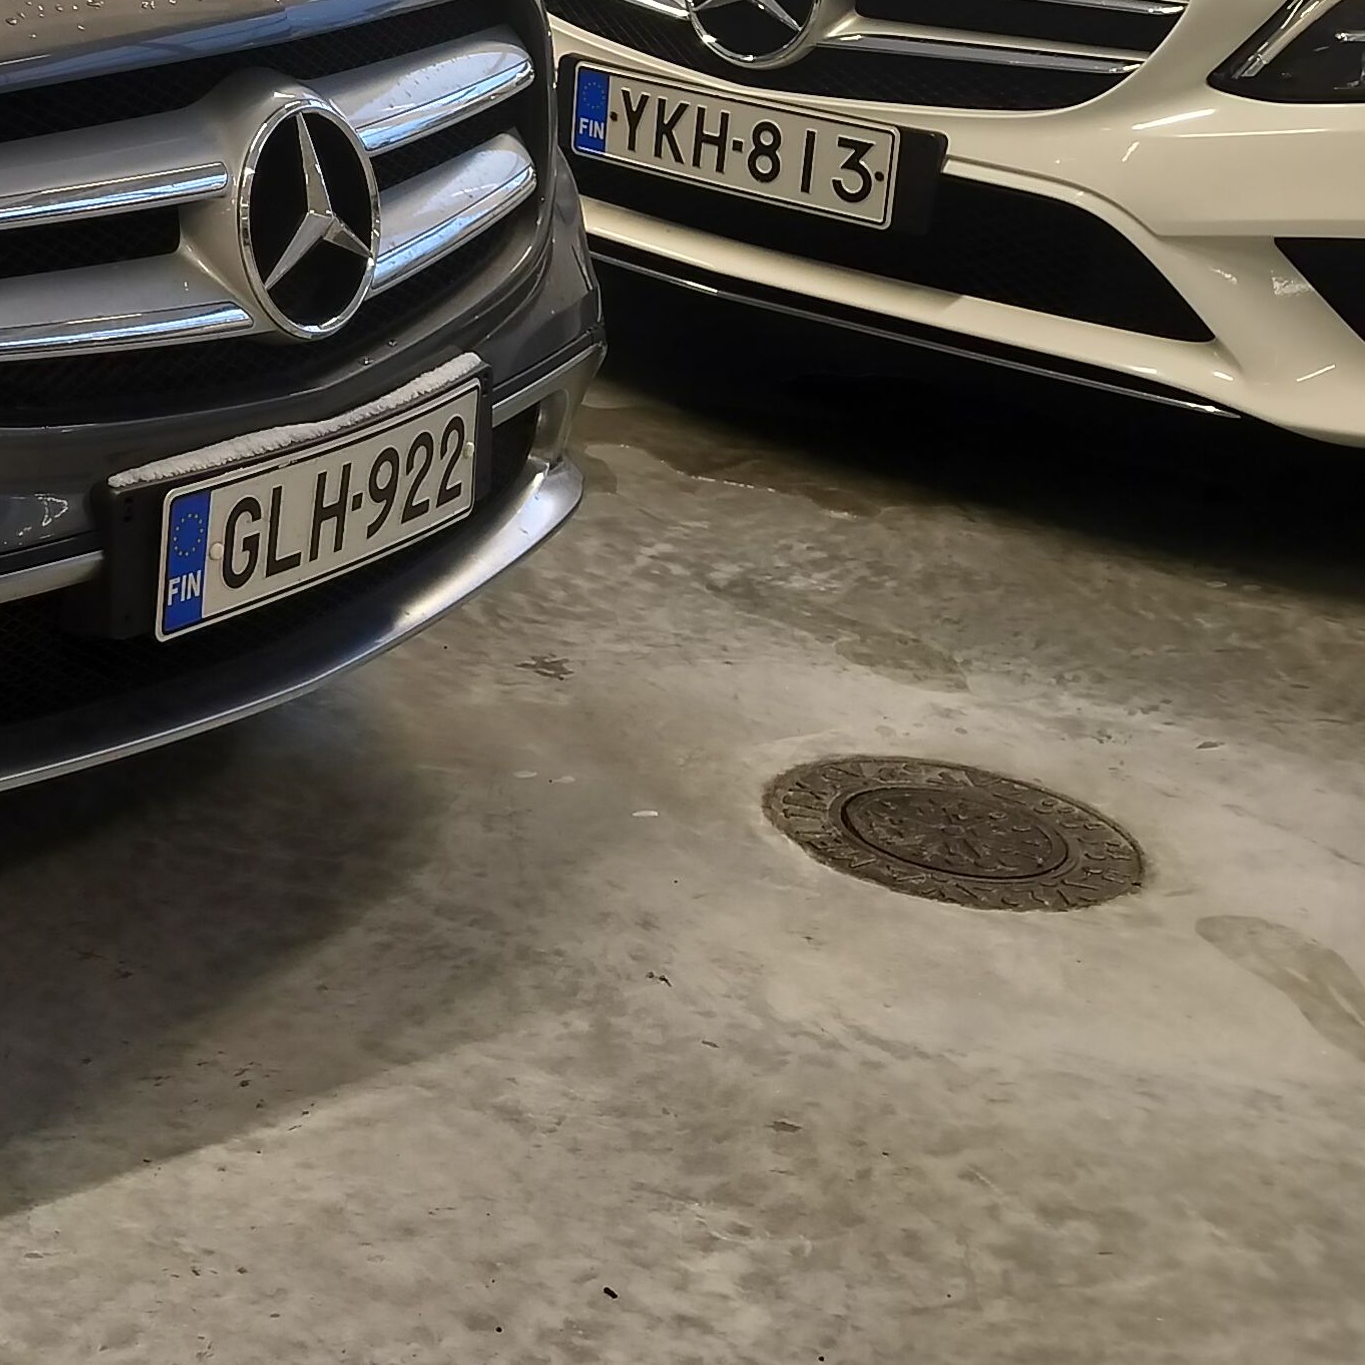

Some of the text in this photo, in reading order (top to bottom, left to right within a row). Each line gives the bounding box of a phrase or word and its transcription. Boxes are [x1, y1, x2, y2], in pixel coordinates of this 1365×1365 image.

[579, 118, 605, 142] FIN
[621, 87, 876, 203] YKH-813
[222, 416, 466, 590] GLH-922
[168, 570, 201, 606] FIN
